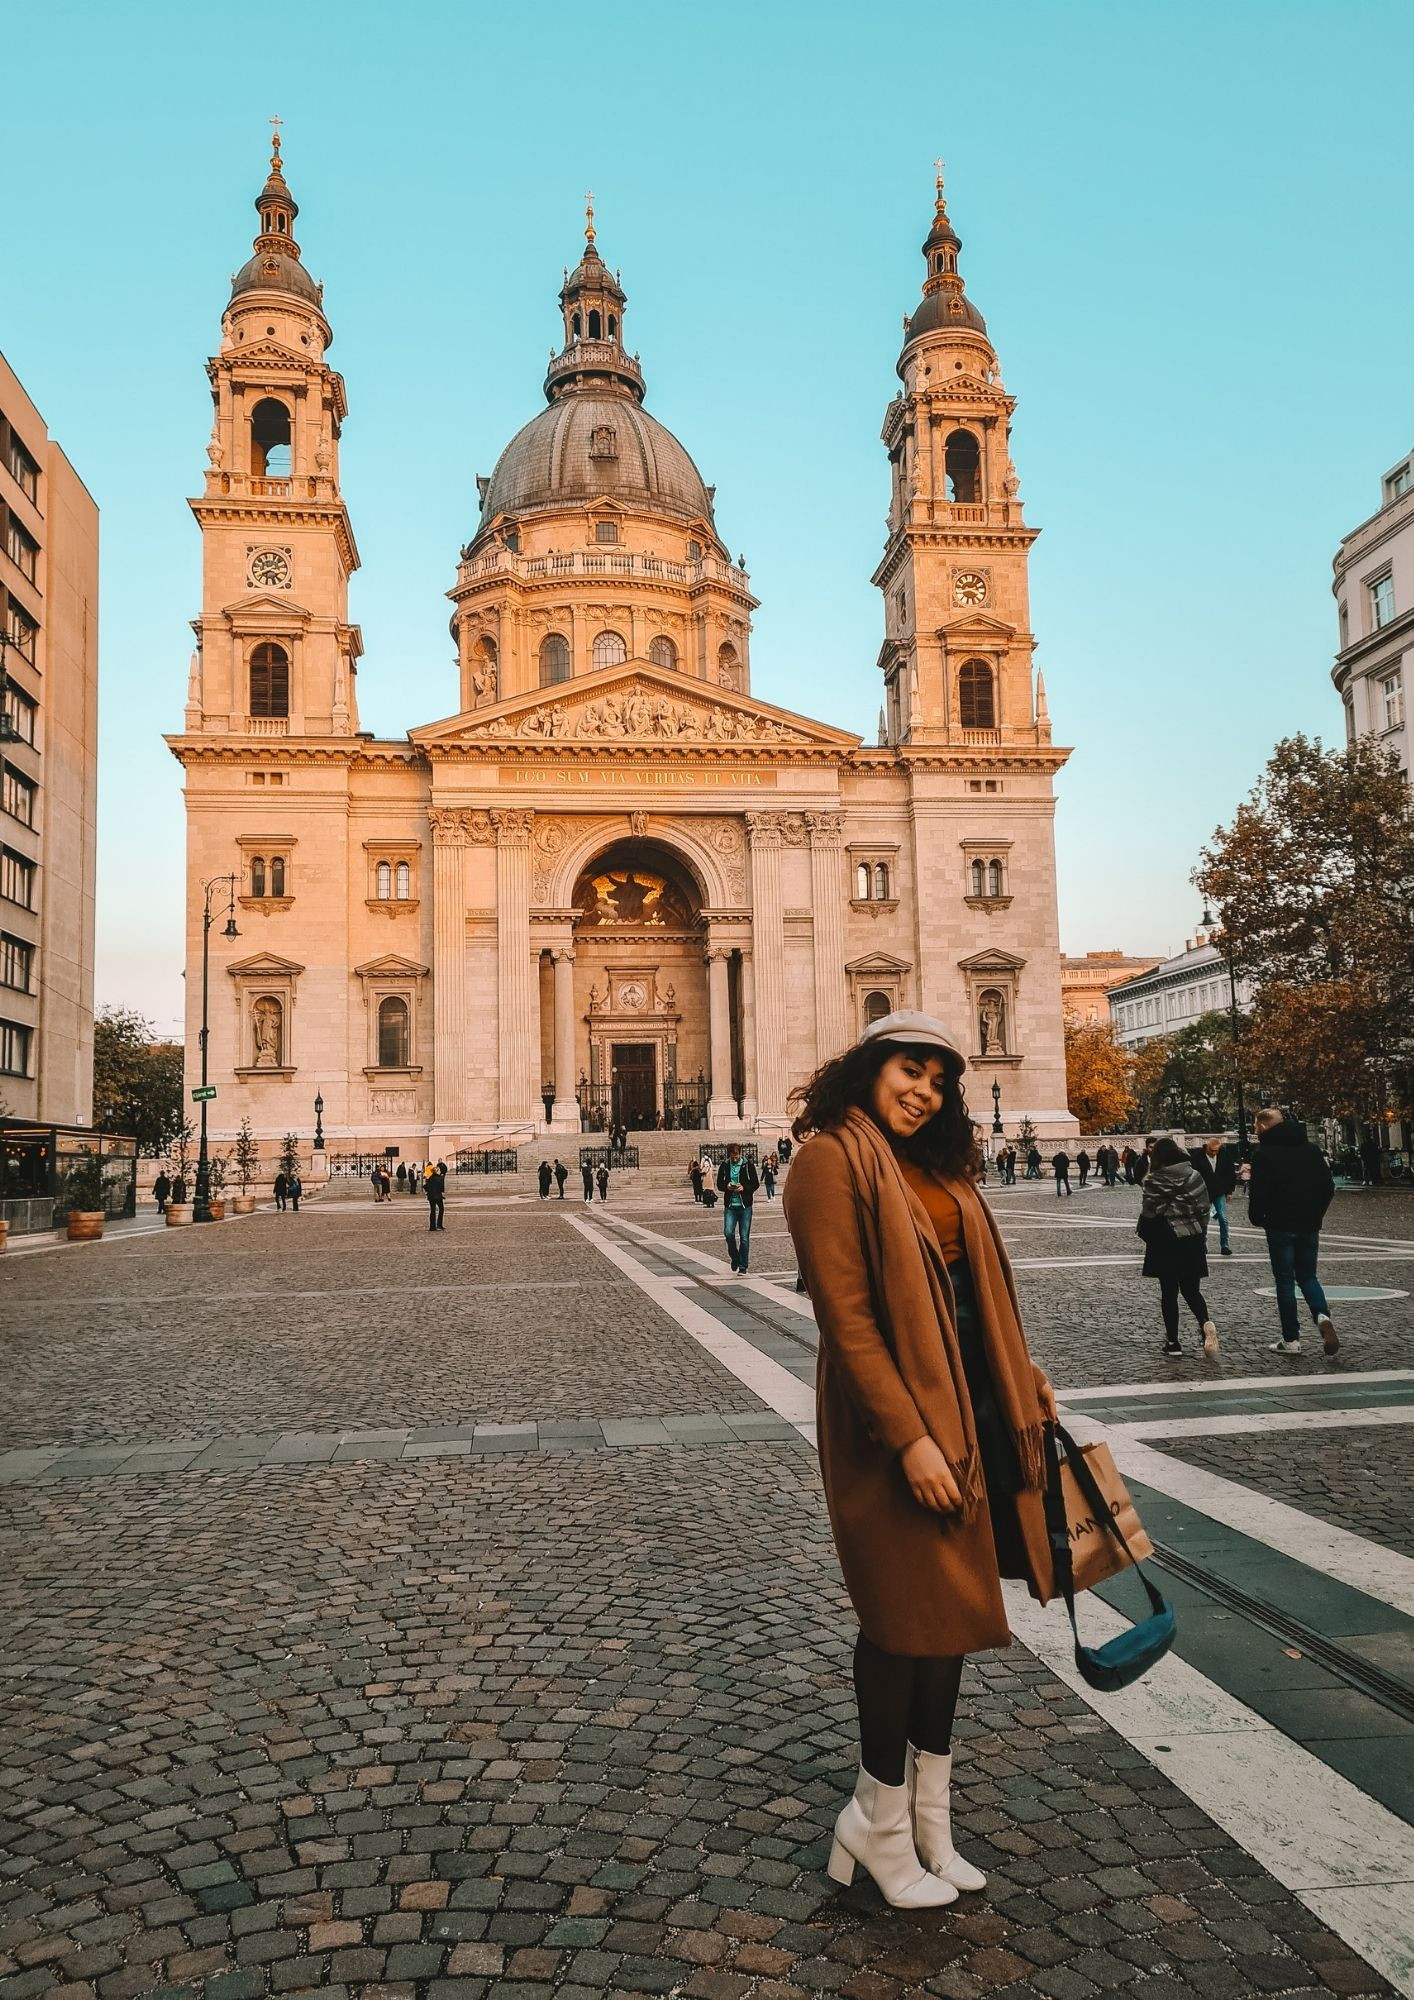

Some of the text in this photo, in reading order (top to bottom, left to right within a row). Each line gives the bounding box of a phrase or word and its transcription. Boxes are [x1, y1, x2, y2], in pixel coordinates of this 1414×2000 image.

[514, 770, 761, 785] EGO SUM VIA VERITAS ET VITA
